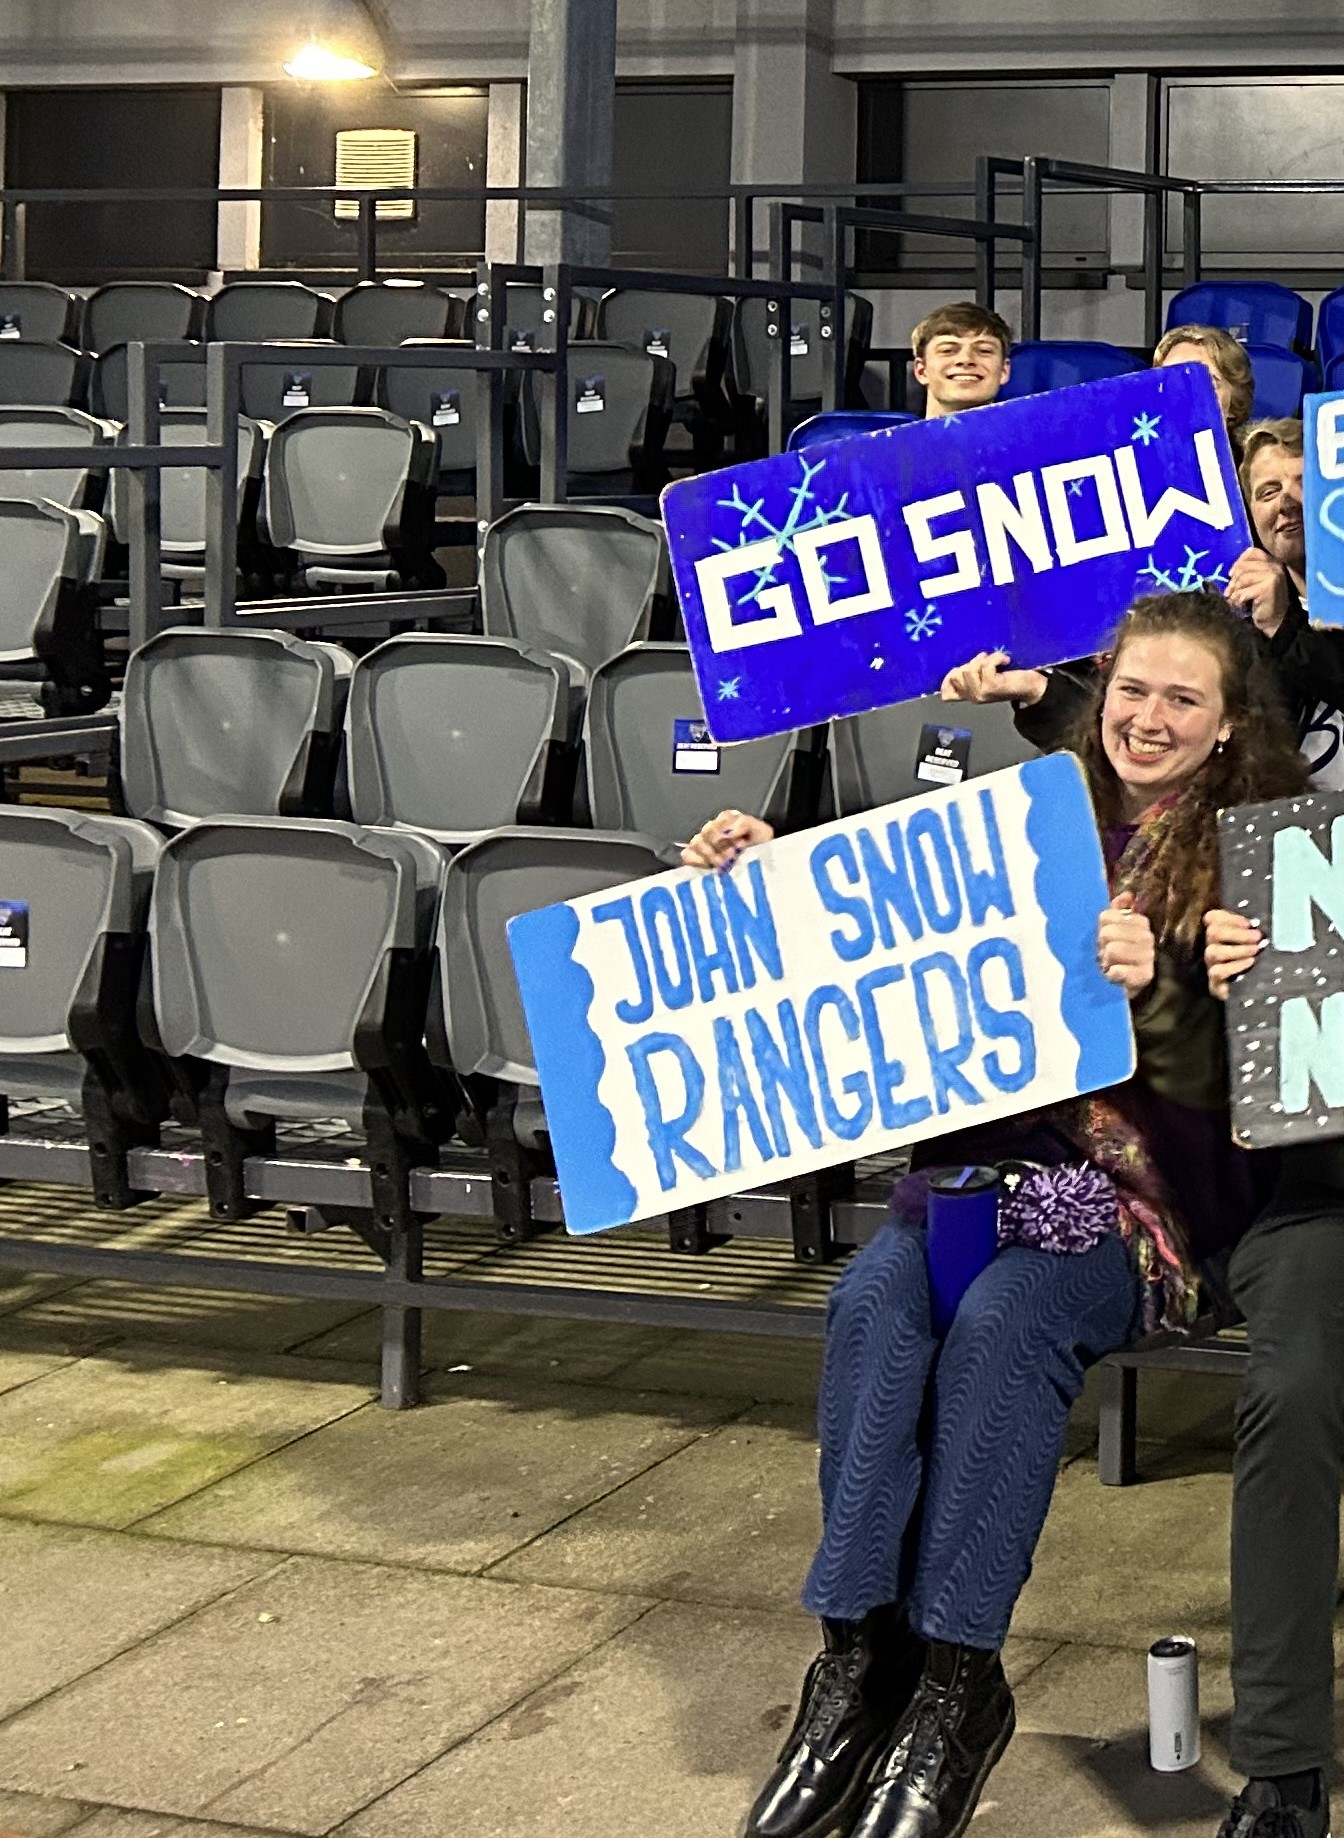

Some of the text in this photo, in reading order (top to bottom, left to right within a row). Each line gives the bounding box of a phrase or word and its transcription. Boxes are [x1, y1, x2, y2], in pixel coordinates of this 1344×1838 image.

[695, 429, 1233, 653] GO SNOW
[593, 789, 1016, 1024] JOHN SNOW
[625, 937, 1036, 1192] RANGERS
